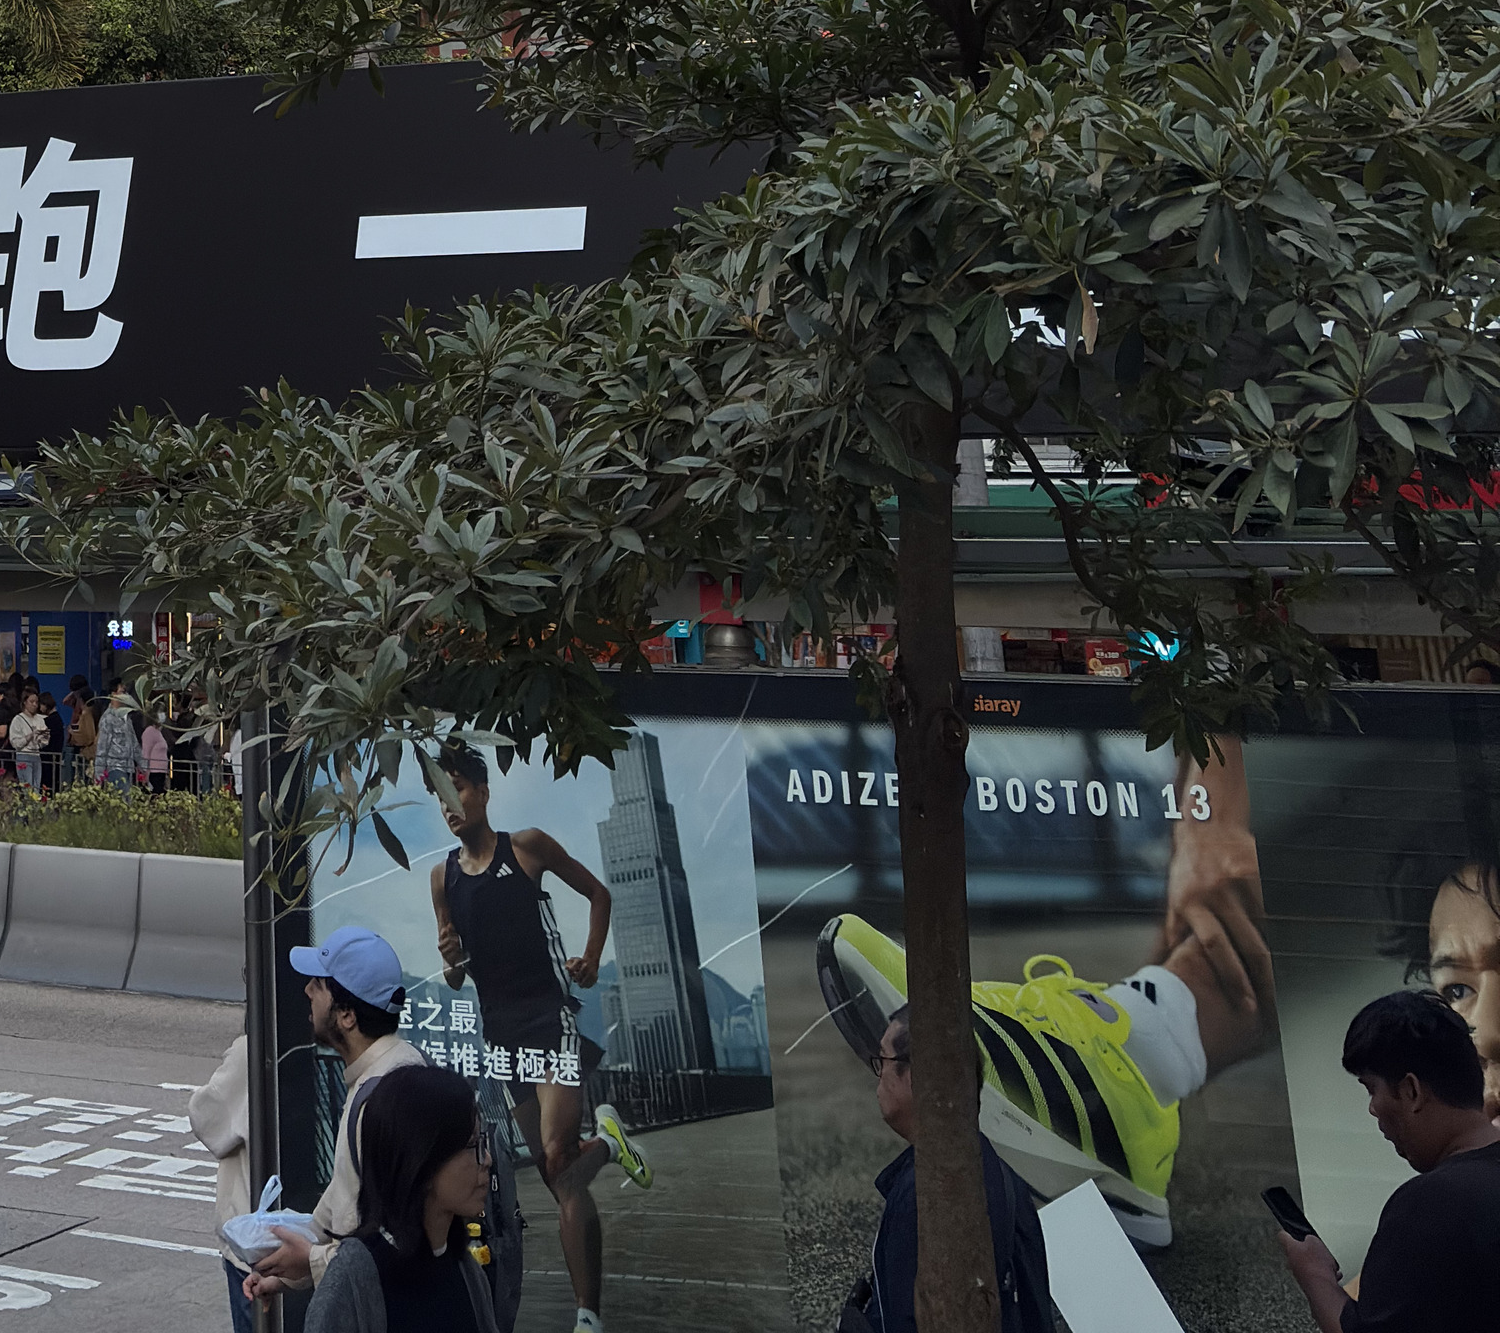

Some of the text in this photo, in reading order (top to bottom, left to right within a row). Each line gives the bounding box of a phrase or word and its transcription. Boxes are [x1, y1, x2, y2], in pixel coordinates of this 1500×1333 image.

[974, 695, 1021, 717] siaray
[787, 769, 1212, 822] ADIZE BOSTON 13
[410, 1039, 582, 1087] 候推進極速
